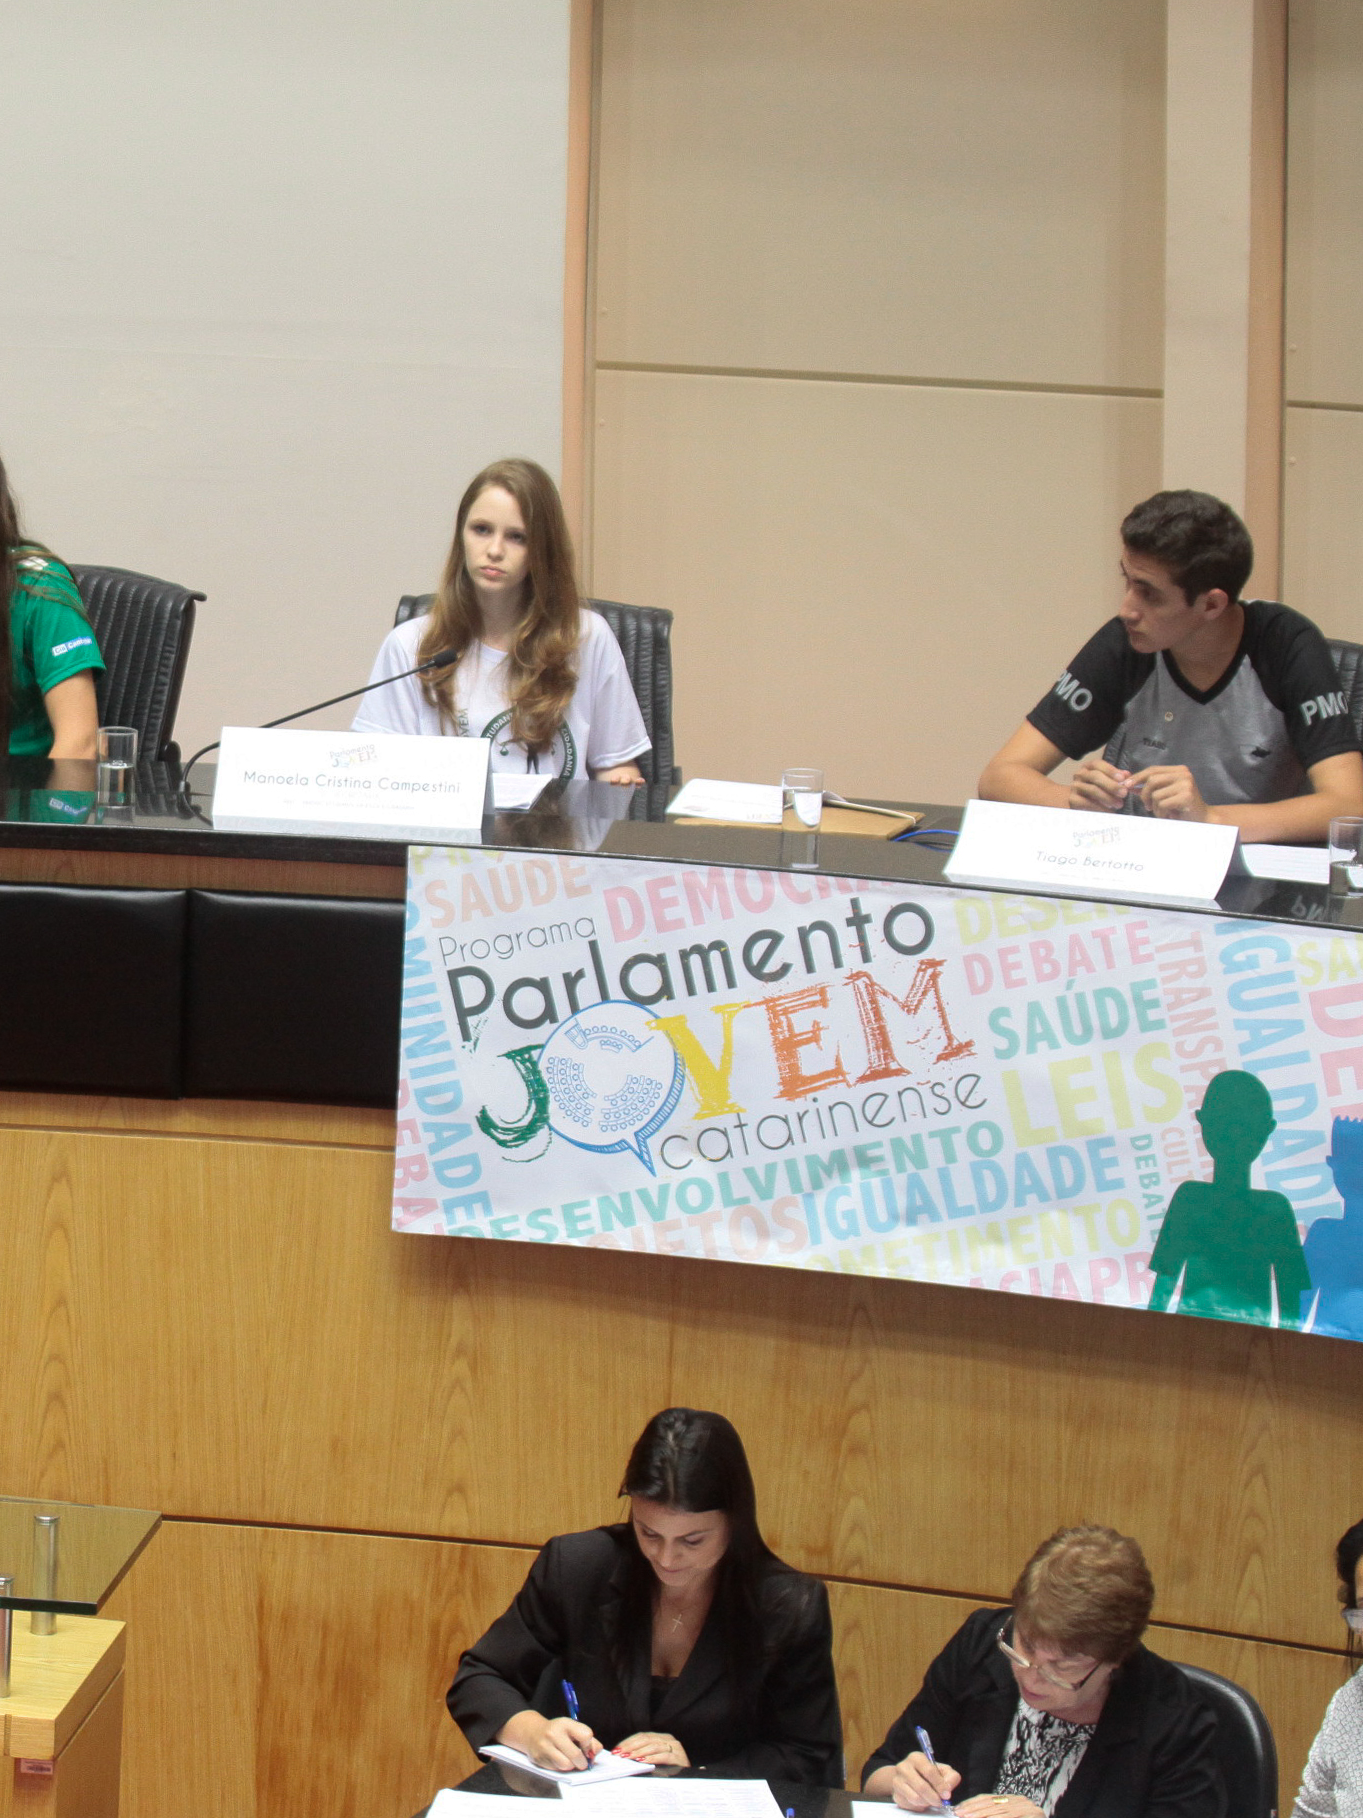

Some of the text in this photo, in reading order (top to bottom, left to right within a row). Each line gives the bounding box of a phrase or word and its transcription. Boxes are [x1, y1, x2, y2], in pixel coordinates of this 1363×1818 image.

[243, 771, 460, 794] Manoela Cristina Campestini
[425, 849, 592, 929] SAÚDE
[1036, 851, 1144, 872] Tiago Bertotto
[439, 917, 597, 966] Programa
[447, 897, 935, 1043] Parlamento
[962, 920, 1155, 995] DEBATE
[988, 977, 1167, 1060] SAÚDE
[660, 1073, 987, 1170] catarinense
[1001, 1042, 1184, 1148] LEIS
[801, 1136, 1125, 1246] IGUALDADE
